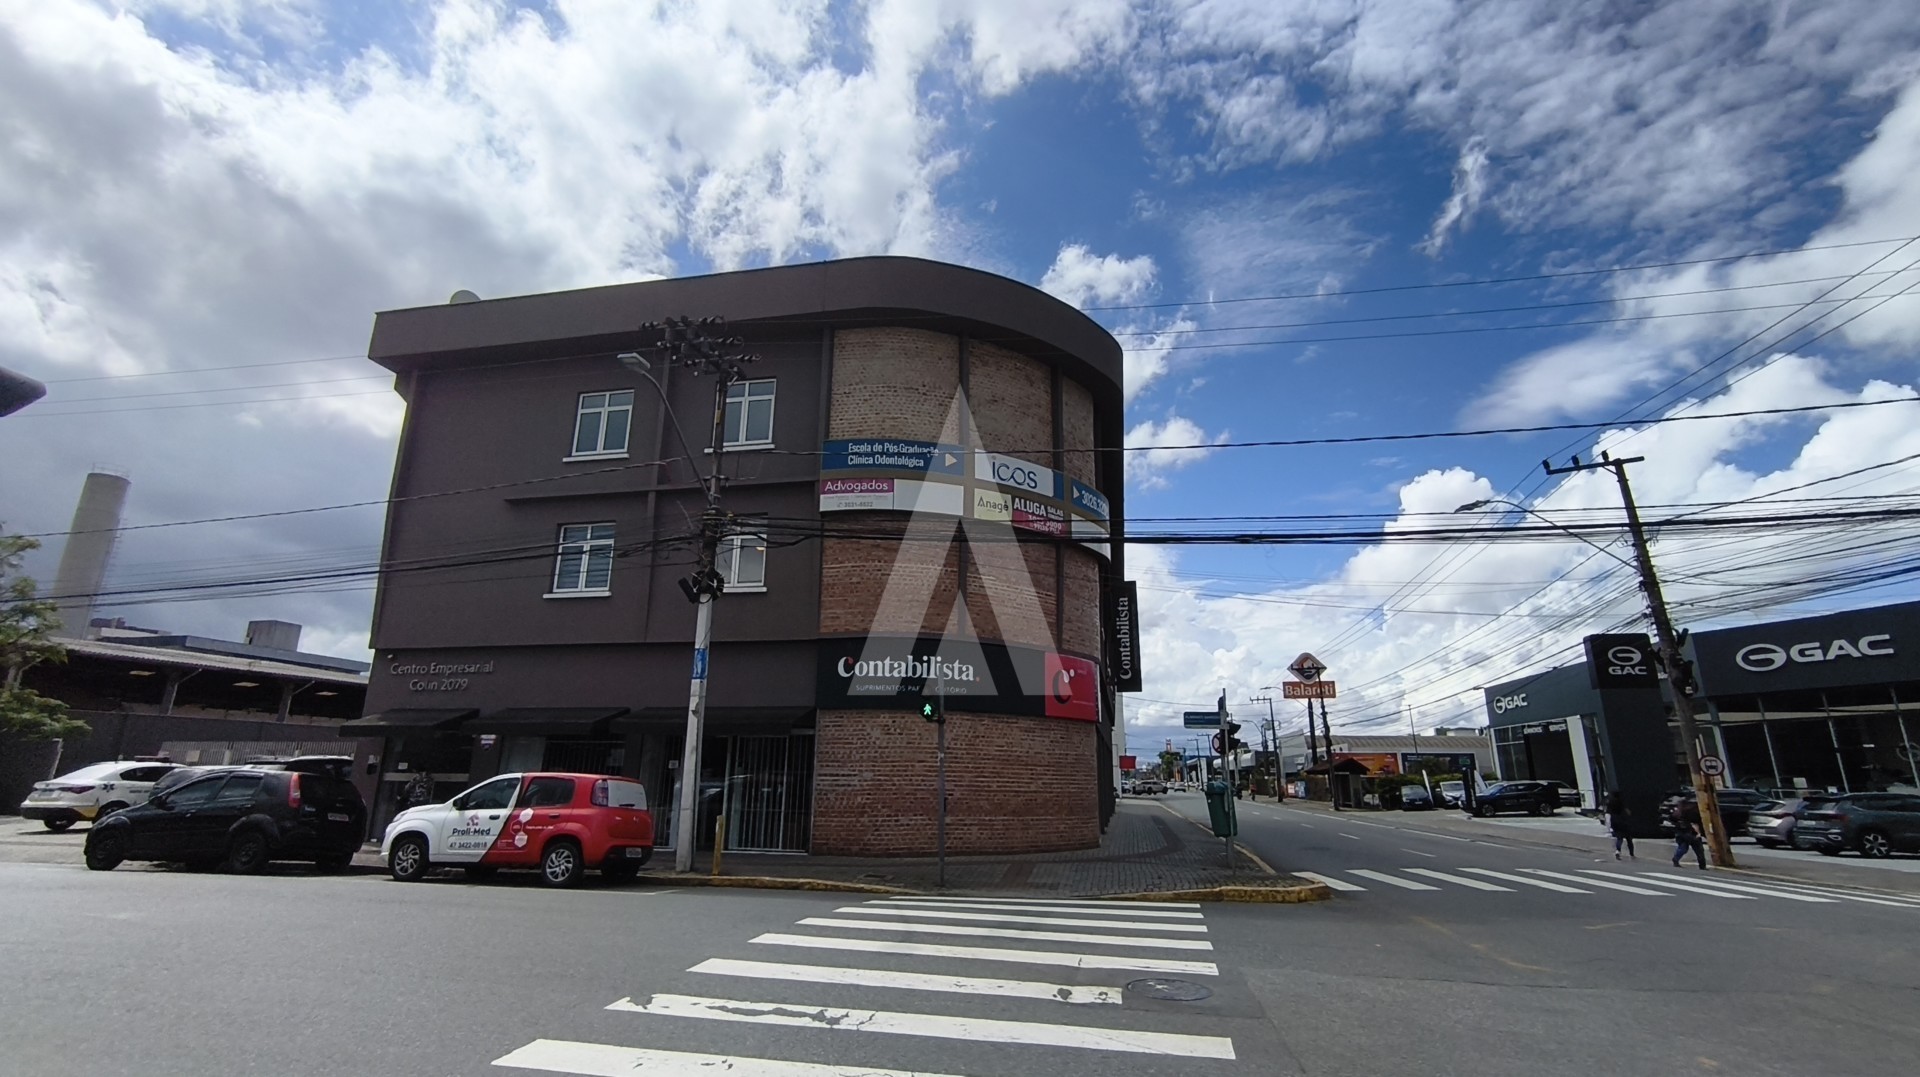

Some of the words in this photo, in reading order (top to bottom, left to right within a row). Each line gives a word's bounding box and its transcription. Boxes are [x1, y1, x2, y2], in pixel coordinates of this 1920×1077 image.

[848, 443, 871, 453] Escola
[873, 443, 882, 453] de
[848, 454, 873, 465] Clínica
[874, 455, 924, 468] Odontológica
[825, 480, 888, 493] Advogados
[978, 495, 1009, 513] Anagê
[1013, 497, 1047, 517] ALUGA
[1116, 597, 1132, 680] Contabilista
[1789, 634, 1895, 663] GAC
[390, 662, 428, 675] Centro
[430, 660, 494, 676] Empresarial
[1608, 666, 1648, 675] GAC
[440, 678, 469, 690] 2079
[856, 684, 906, 692] SUPRIMENTOS
[1505, 693, 1528, 709] GAC
